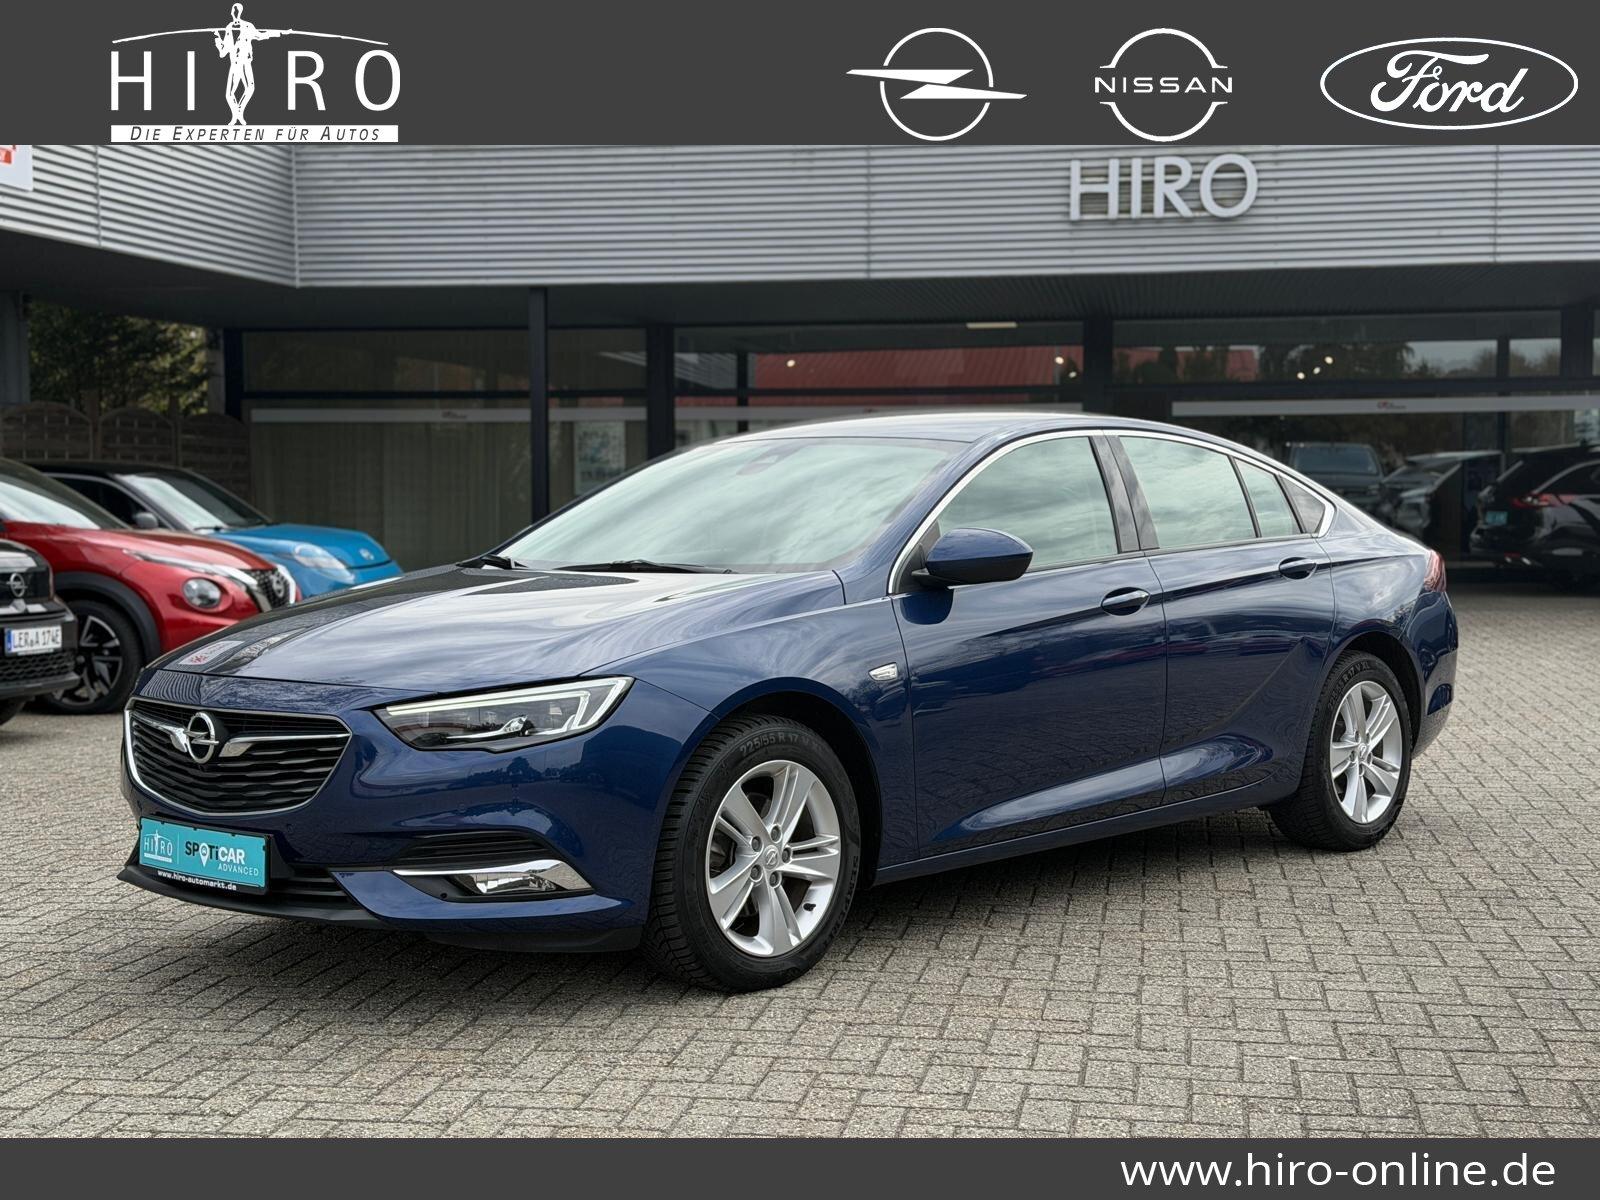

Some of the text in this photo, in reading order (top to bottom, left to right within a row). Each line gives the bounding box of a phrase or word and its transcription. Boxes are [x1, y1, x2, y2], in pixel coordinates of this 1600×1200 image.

[1069, 153, 1258, 221] HIRO
[740, 732, 777, 757] 225/55
[777, 730, 787, 743] R
[789, 732, 799, 743] 17
[157, 869, 238, 891] www.hiro-automarkt.de
[218, 863, 260, 876] ADVANCED
